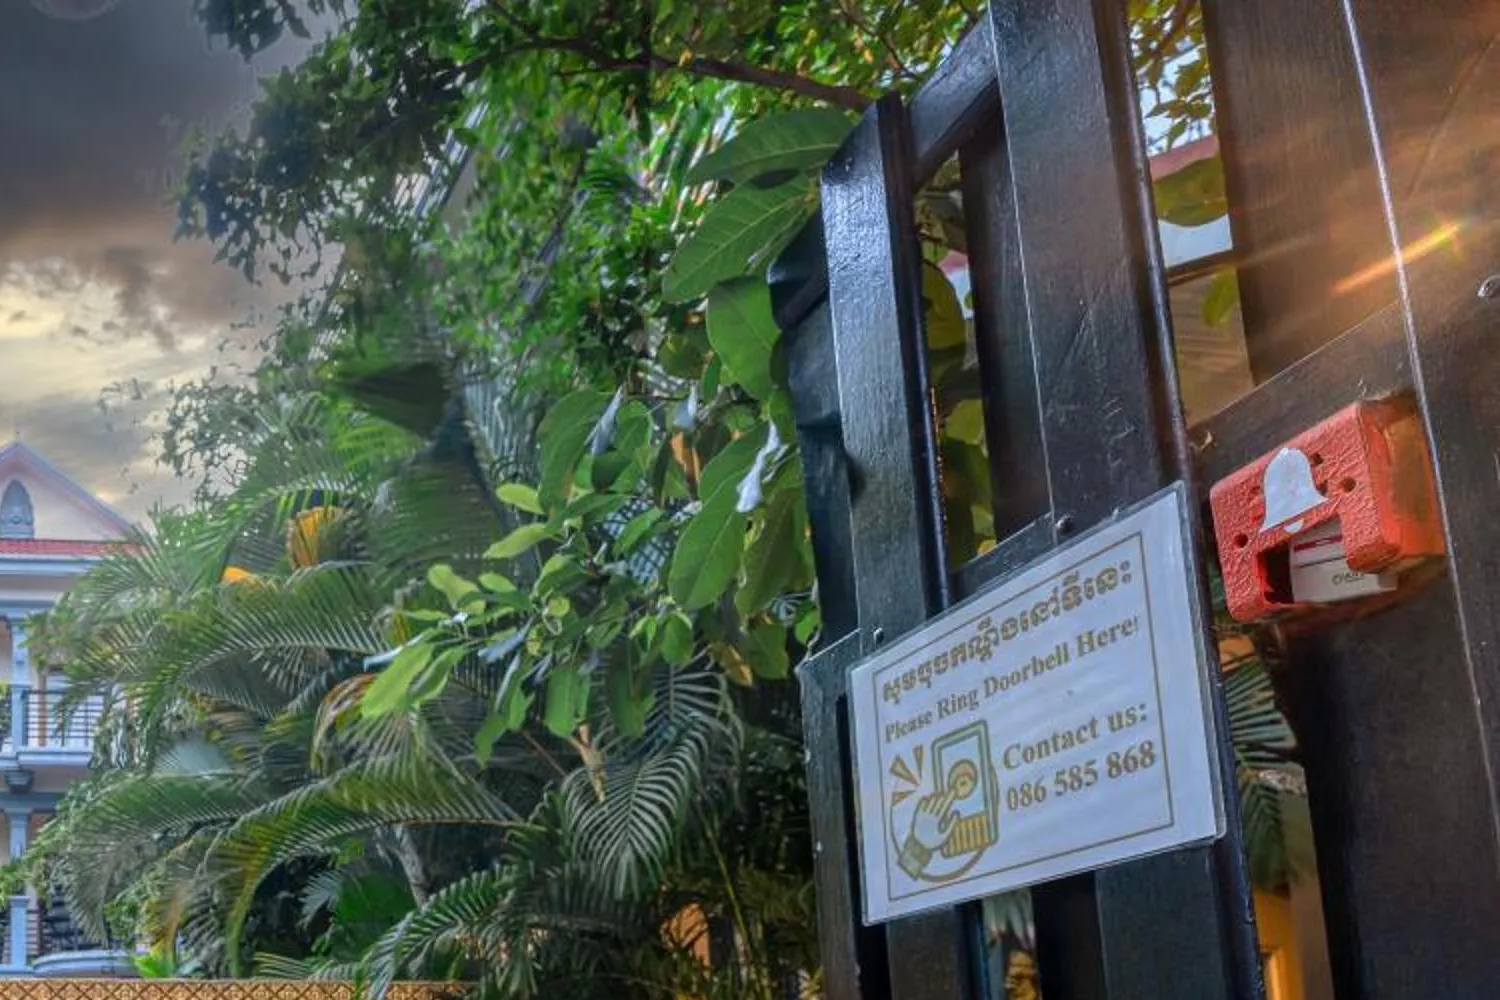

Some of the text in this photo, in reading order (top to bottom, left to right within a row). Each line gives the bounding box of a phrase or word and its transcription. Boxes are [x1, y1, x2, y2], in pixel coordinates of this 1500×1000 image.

[886, 709, 933, 743] Please
[937, 687, 980, 718] Ring
[983, 644, 1070, 698] Doorbell
[1002, 702, 1148, 772] Contact us:
[1006, 740, 1157, 812] 086 585 868
